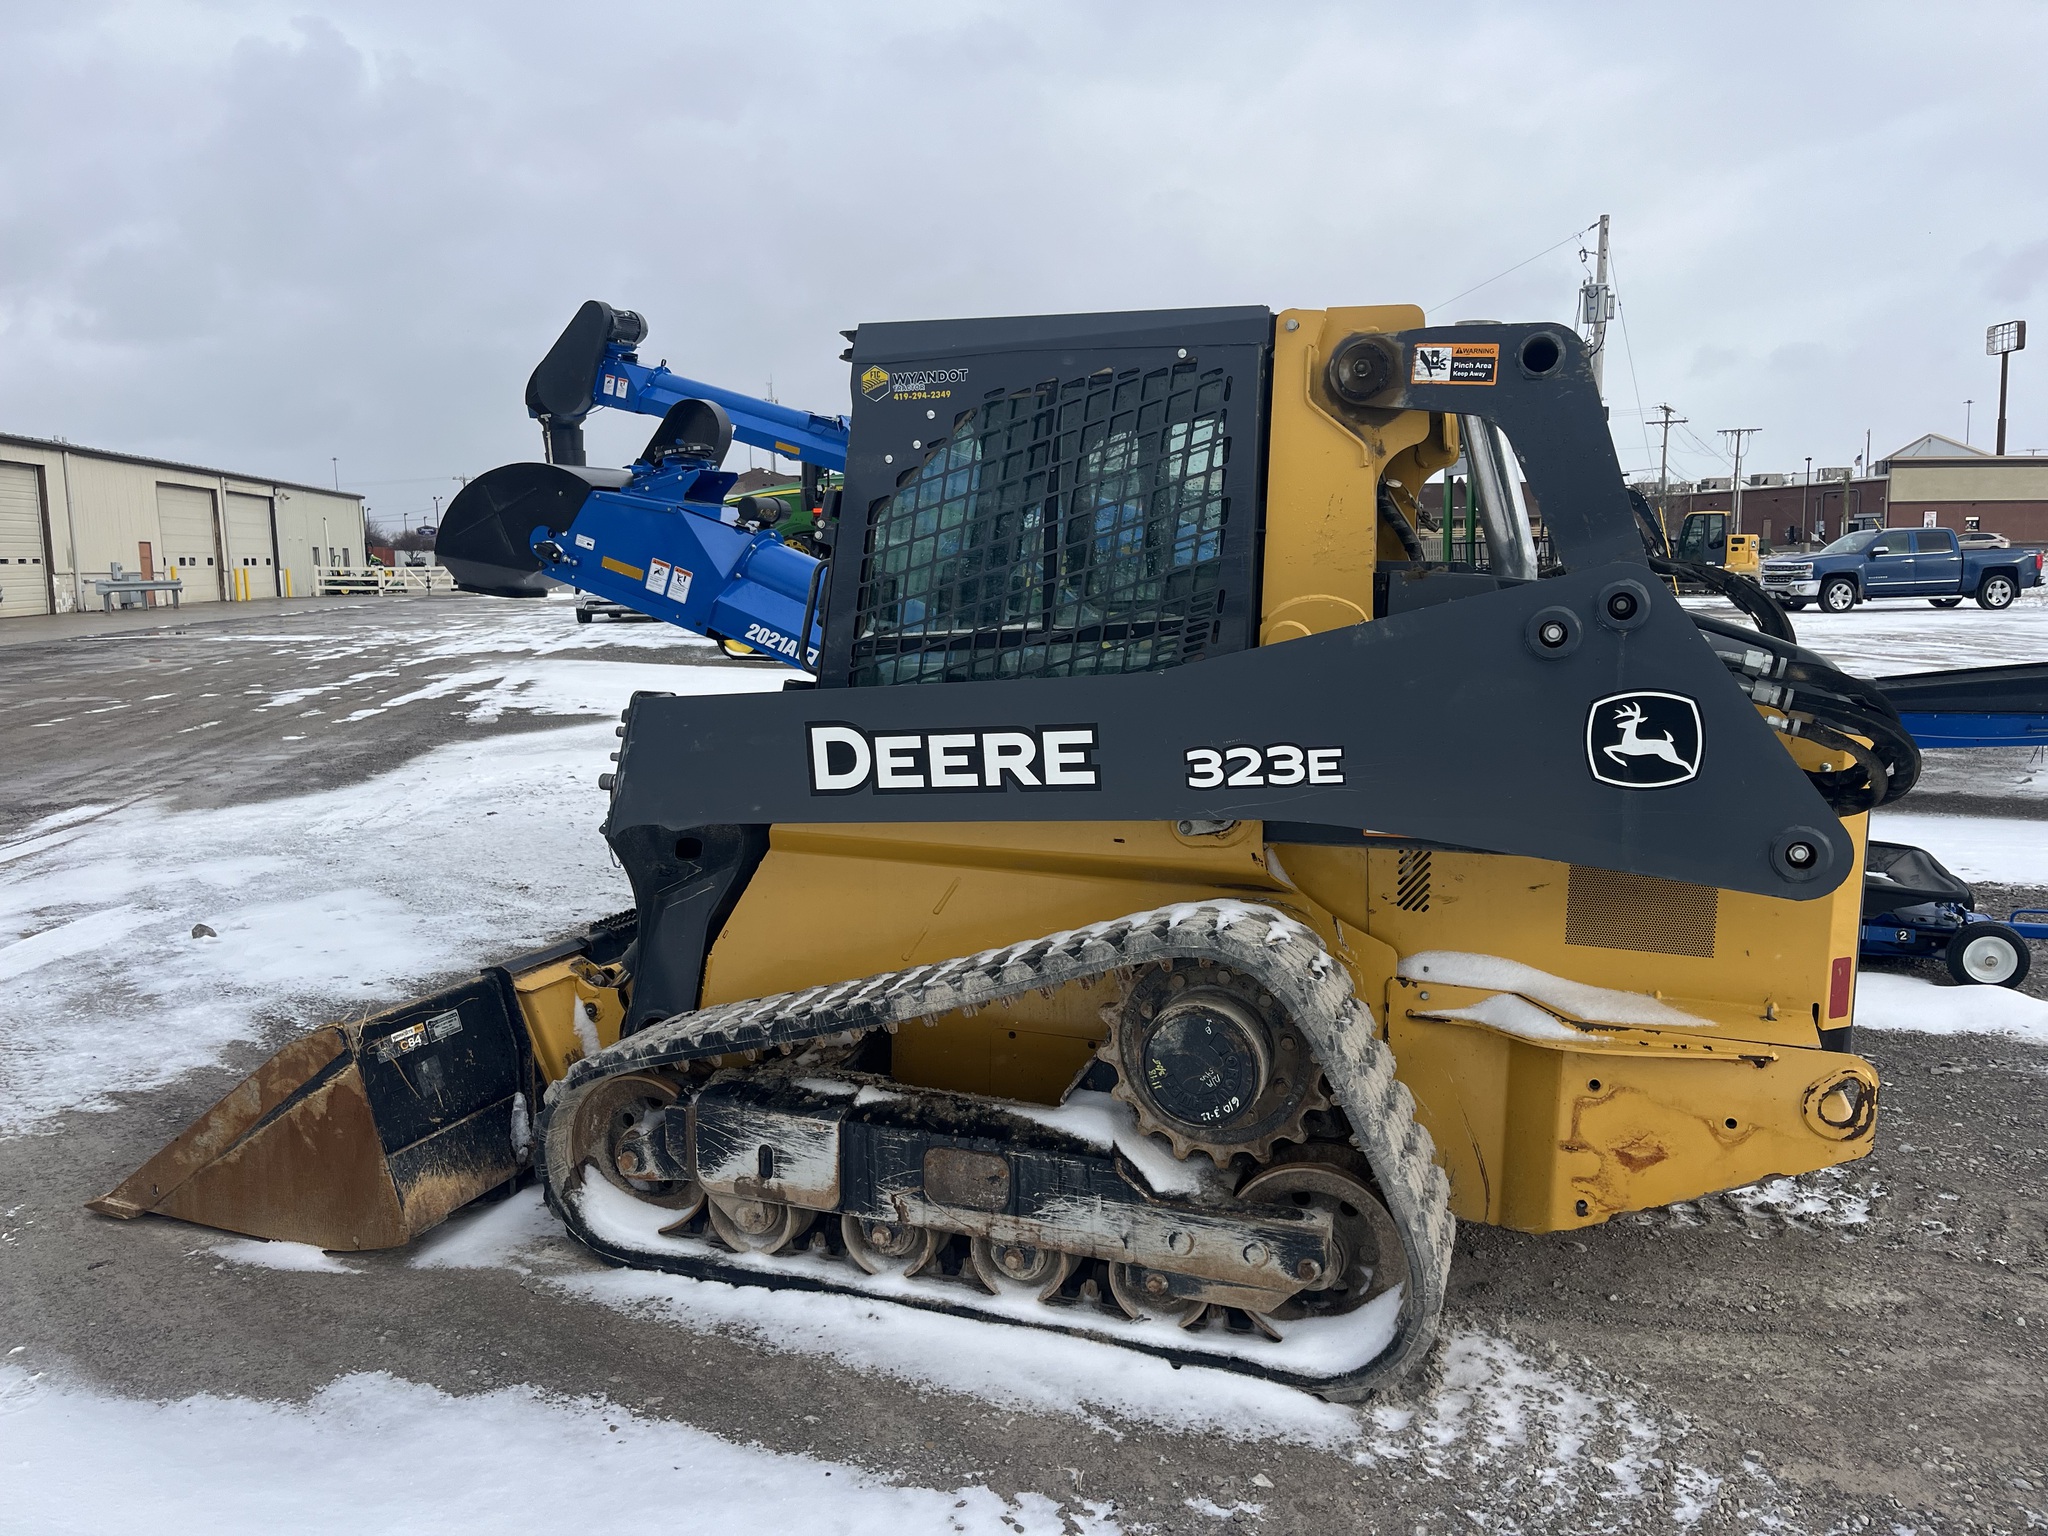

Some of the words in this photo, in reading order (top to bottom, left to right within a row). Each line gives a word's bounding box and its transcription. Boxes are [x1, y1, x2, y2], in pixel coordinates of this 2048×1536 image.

[893, 368, 969, 385] WYANDOT
[893, 383, 926, 392] TRACTOR
[893, 390, 951, 401] 419-294-2349
[811, 726, 1097, 790] DEERE
[1186, 745, 1344, 788] 323E
[400, 1034, 422, 1050] C84
